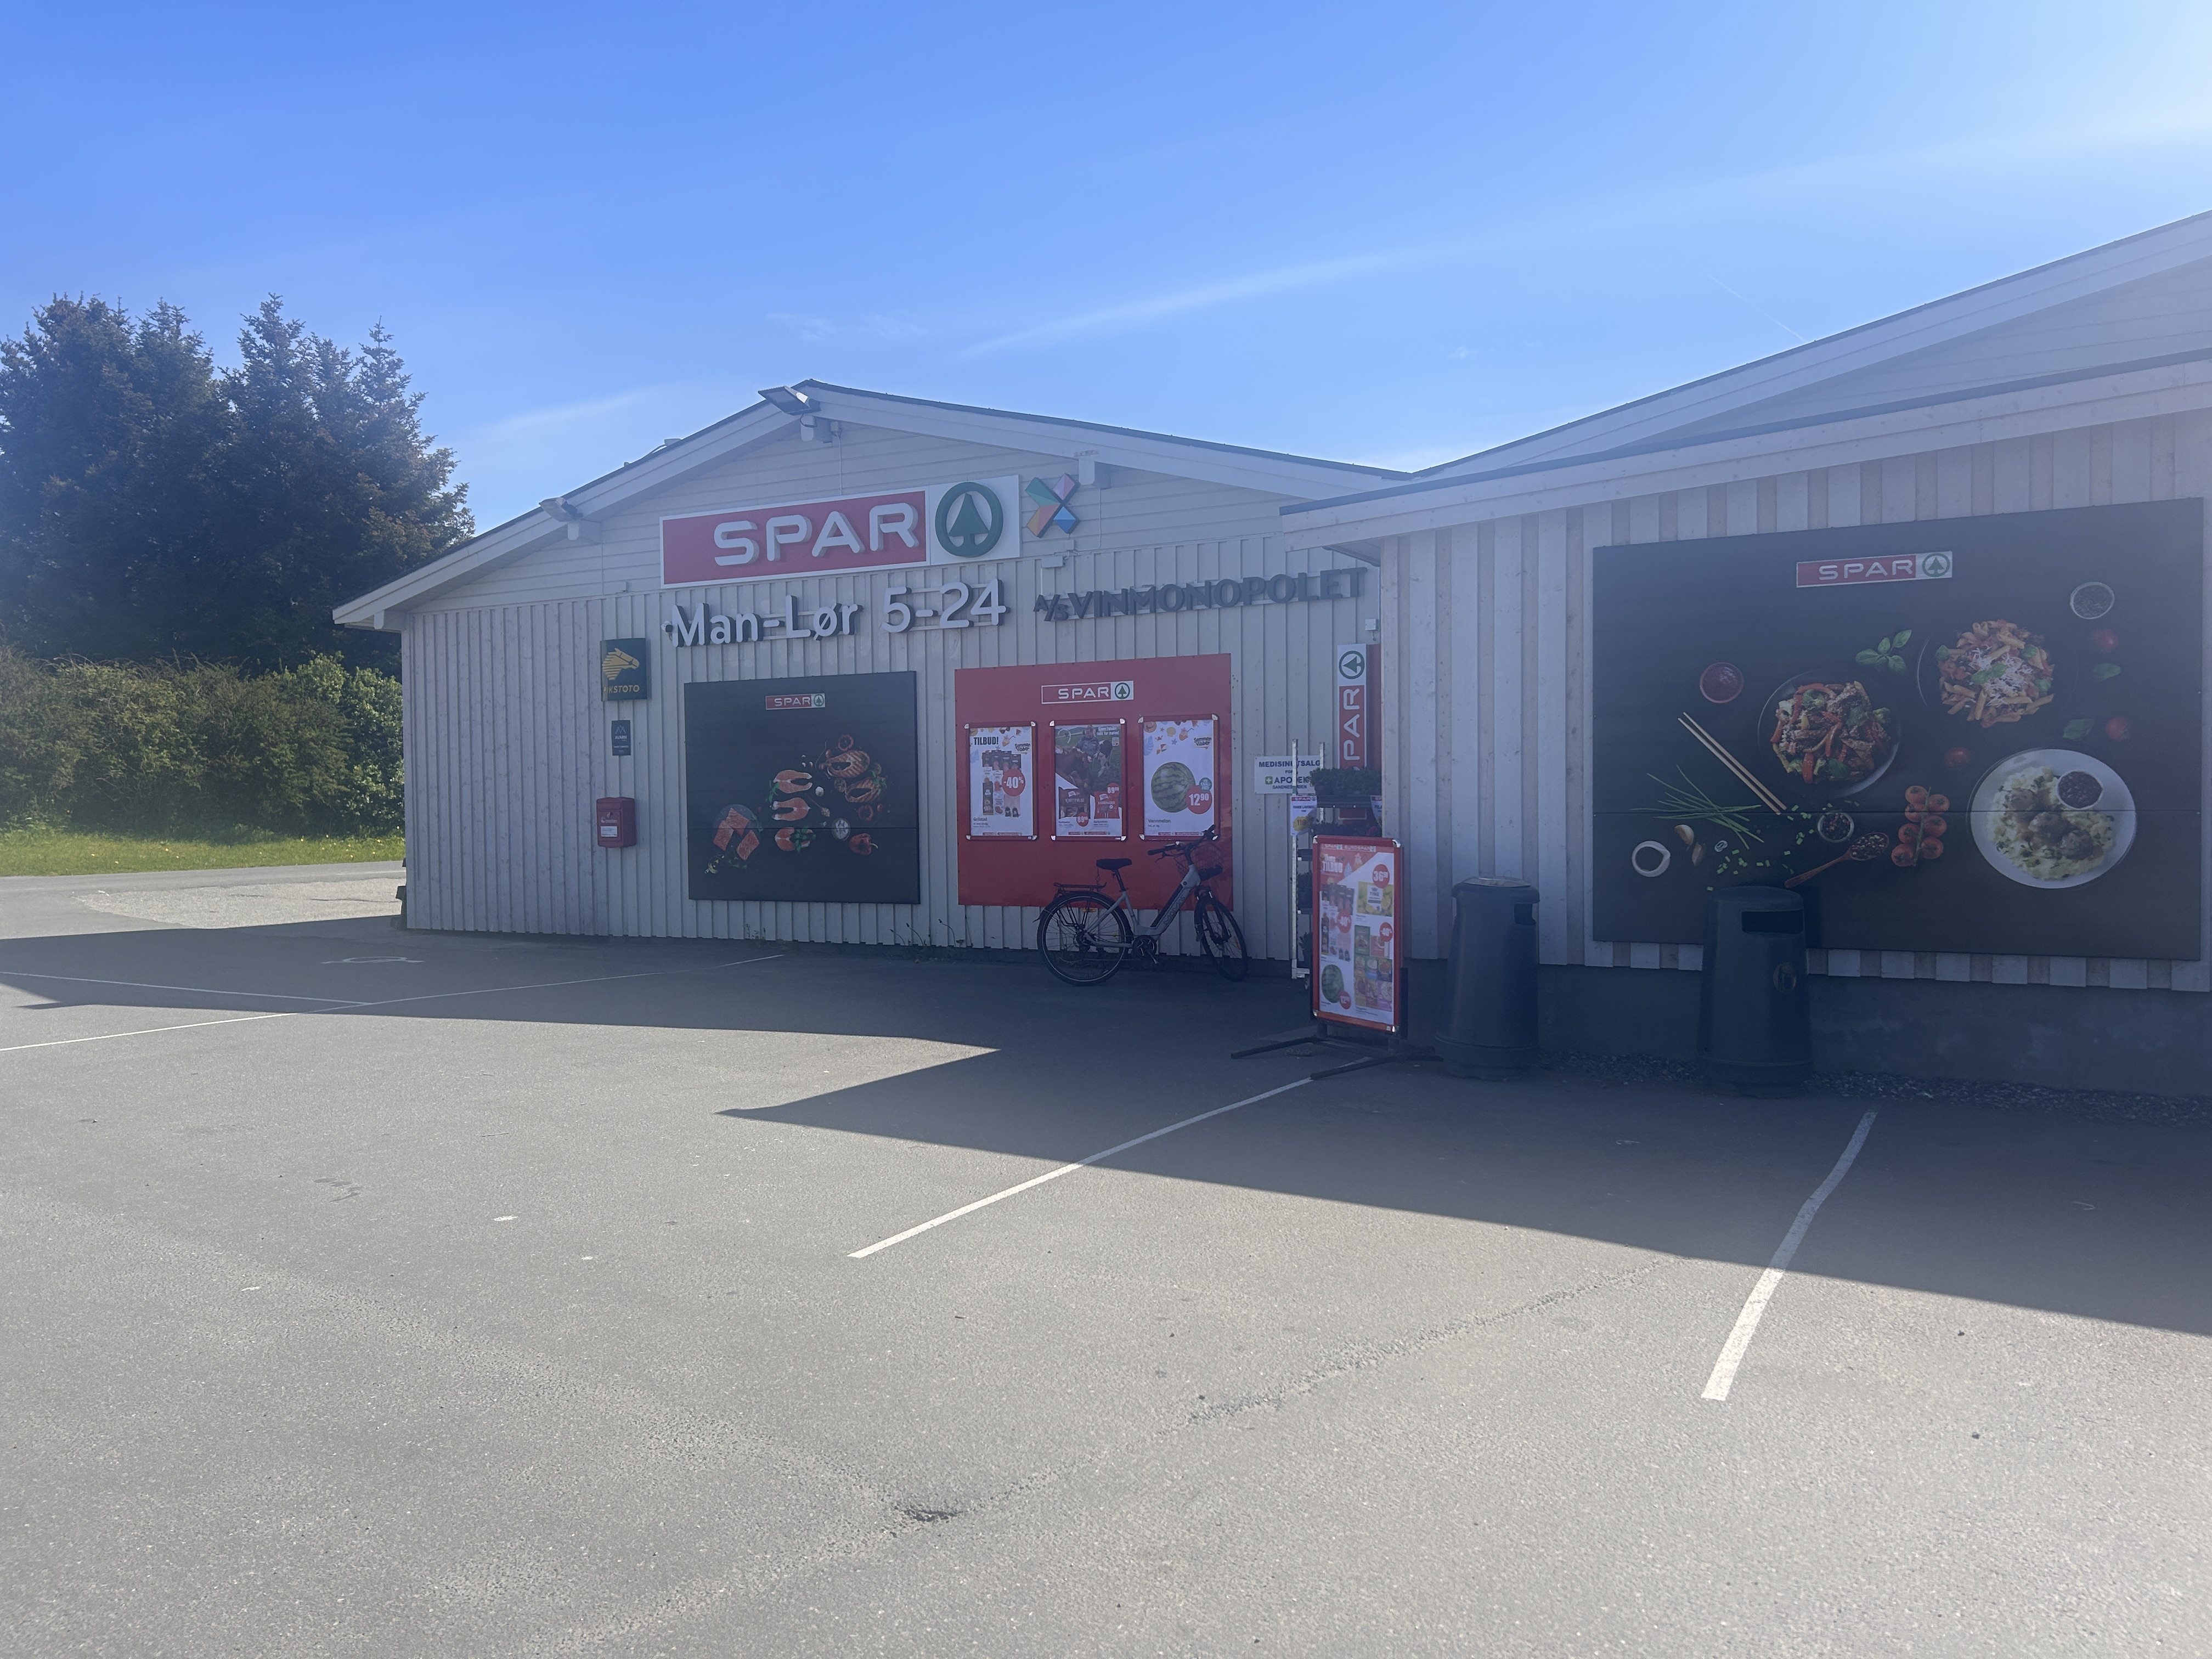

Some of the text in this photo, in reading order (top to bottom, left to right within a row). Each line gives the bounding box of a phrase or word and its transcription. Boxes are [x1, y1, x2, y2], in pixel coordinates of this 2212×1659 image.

[714, 502, 919, 566] SPAR
[1819, 558, 1913, 580] SPAR
[1068, 566, 1367, 620] VINMONOPOLET
[671, 579, 1010, 648] Man-Lør 5-24
[1058, 686, 1109, 699] SPAR
[774, 697, 811, 707] SPAR
[1342, 687, 1361, 769] PAR
[973, 736, 999, 746] TILBUD!
[1003, 776, 1024, 789] -40%
[1273, 776, 1309, 784] APOEK
